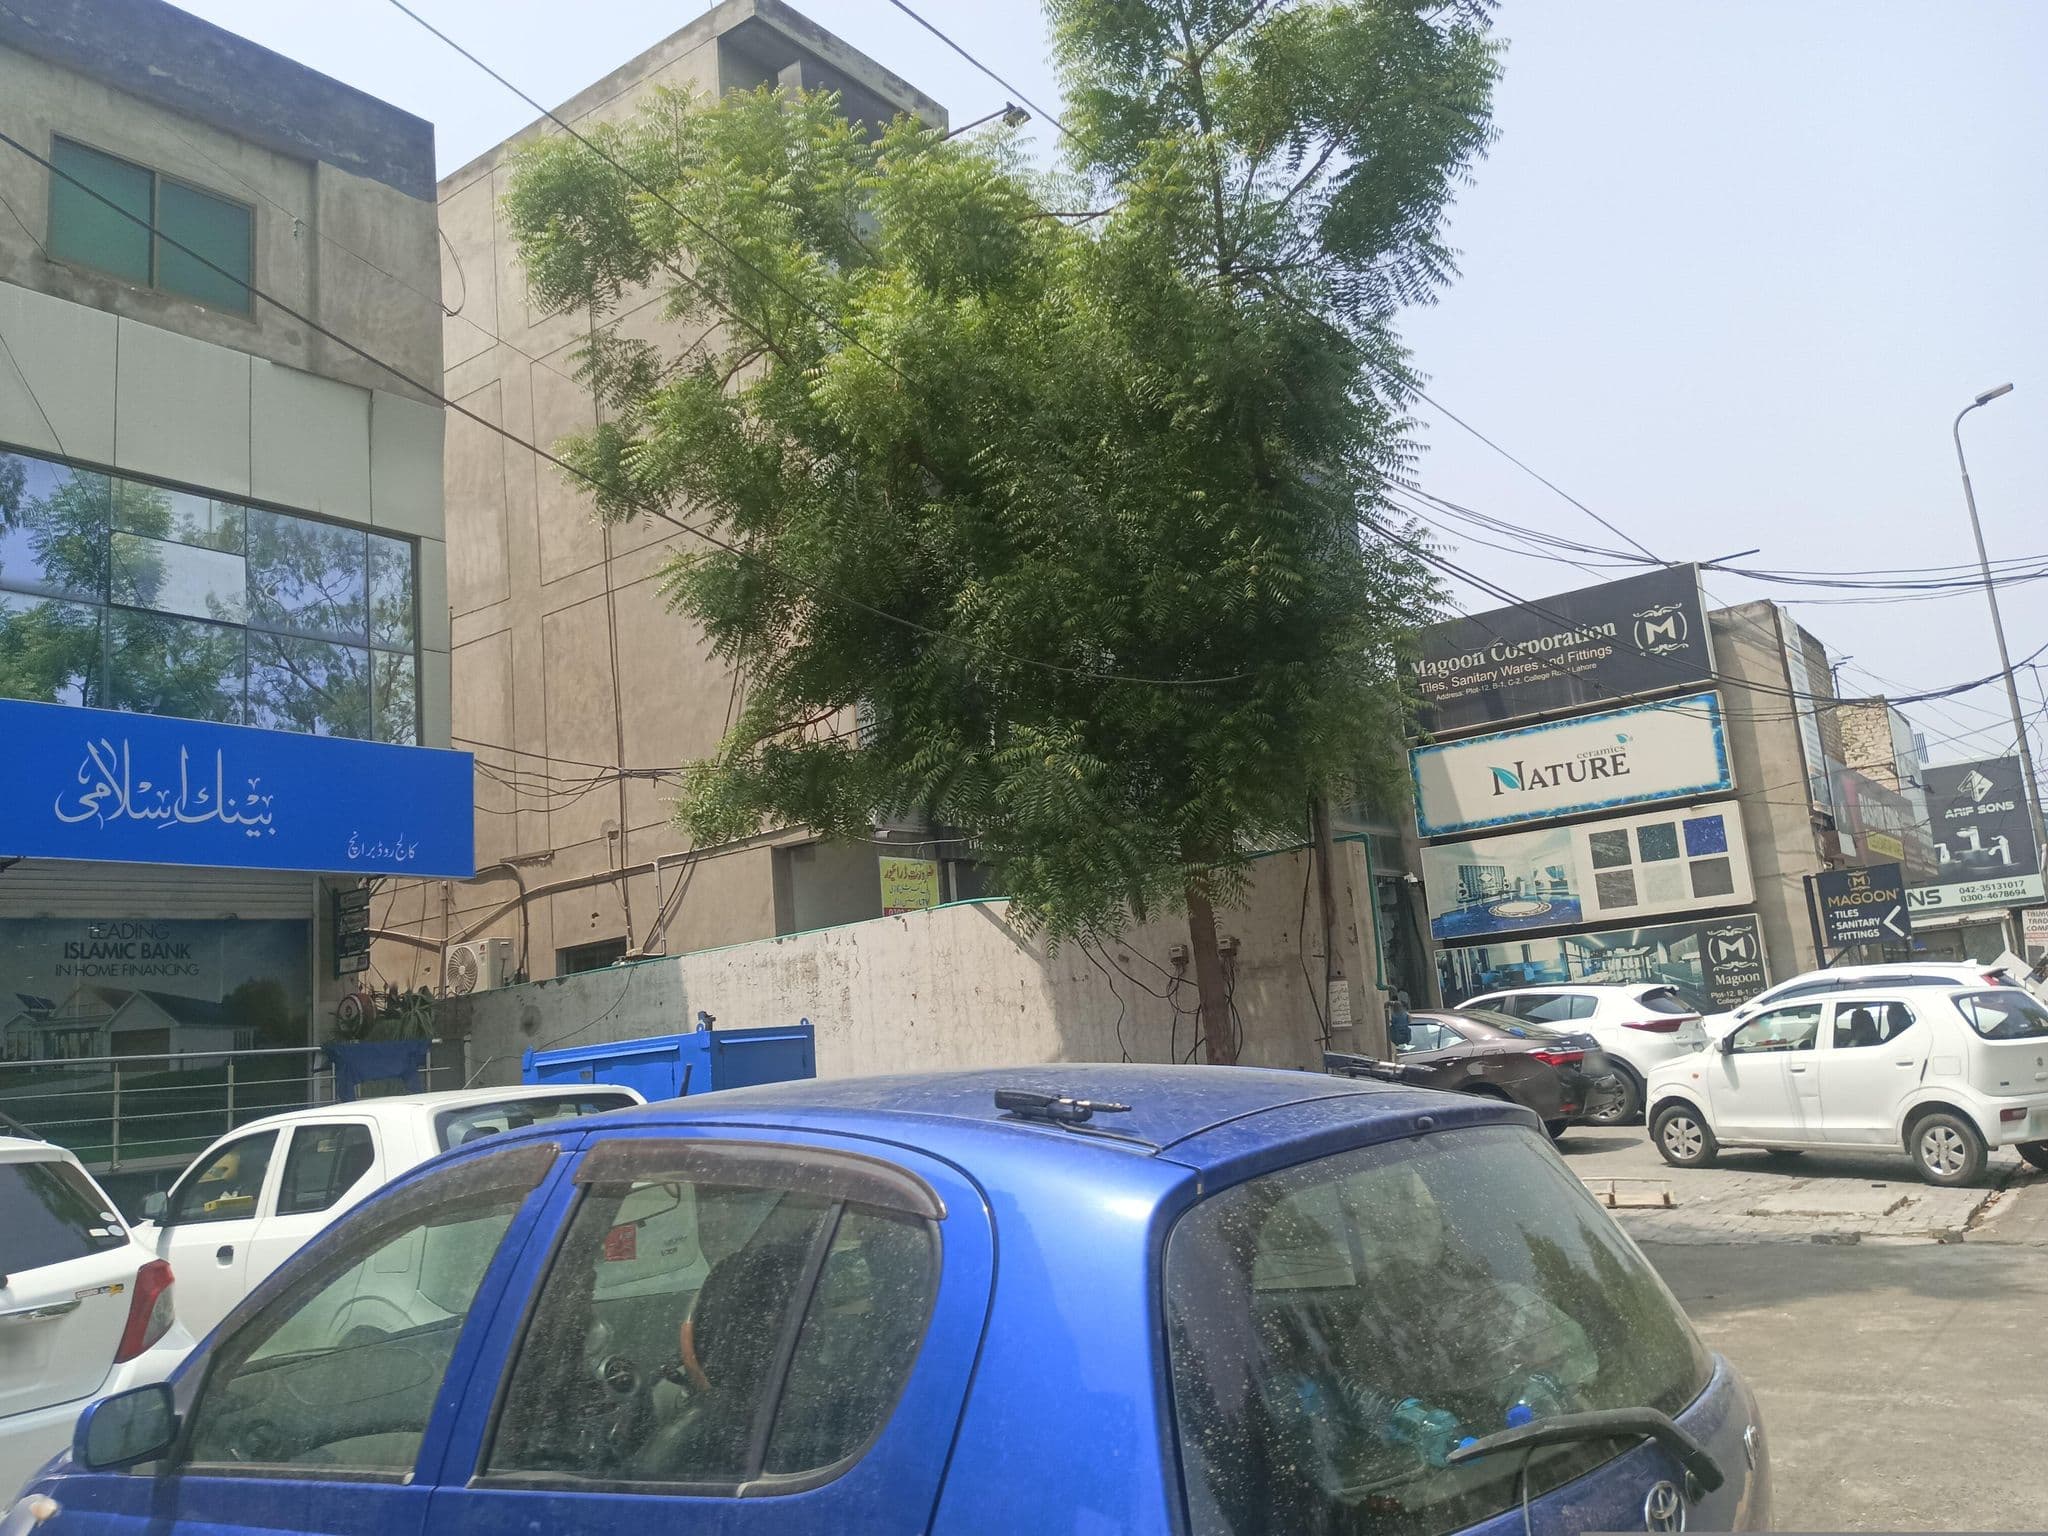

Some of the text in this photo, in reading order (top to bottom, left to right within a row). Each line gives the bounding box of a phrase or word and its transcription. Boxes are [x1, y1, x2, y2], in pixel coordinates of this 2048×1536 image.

[1410, 622, 1618, 679] Magoon Corporation
[1419, 681, 1449, 694] Tiles,
[1451, 670, 1498, 688] Sanitary
[1500, 661, 1539, 677] Wares
[1568, 645, 1613, 663] Fittings
[1576, 745, 1626, 759] ceramics
[1944, 800, 2016, 819] ARIF SONS
[1958, 879, 2026, 895] 042-35131017
[1827, 888, 1897, 908] MAGOON
[1960, 888, 2028, 903] 0300-4678694
[1834, 908, 1860, 919] TILES
[88, 921, 171, 941] LEADING
[1835, 917, 1880, 930] SANITARY
[1838, 928, 1880, 941] FITTINGS
[64, 941, 192, 960] ISLAMIC BANK
[55, 963, 200, 977] IN HOME FINANCING
[1715, 972, 1761, 987] Magoon
